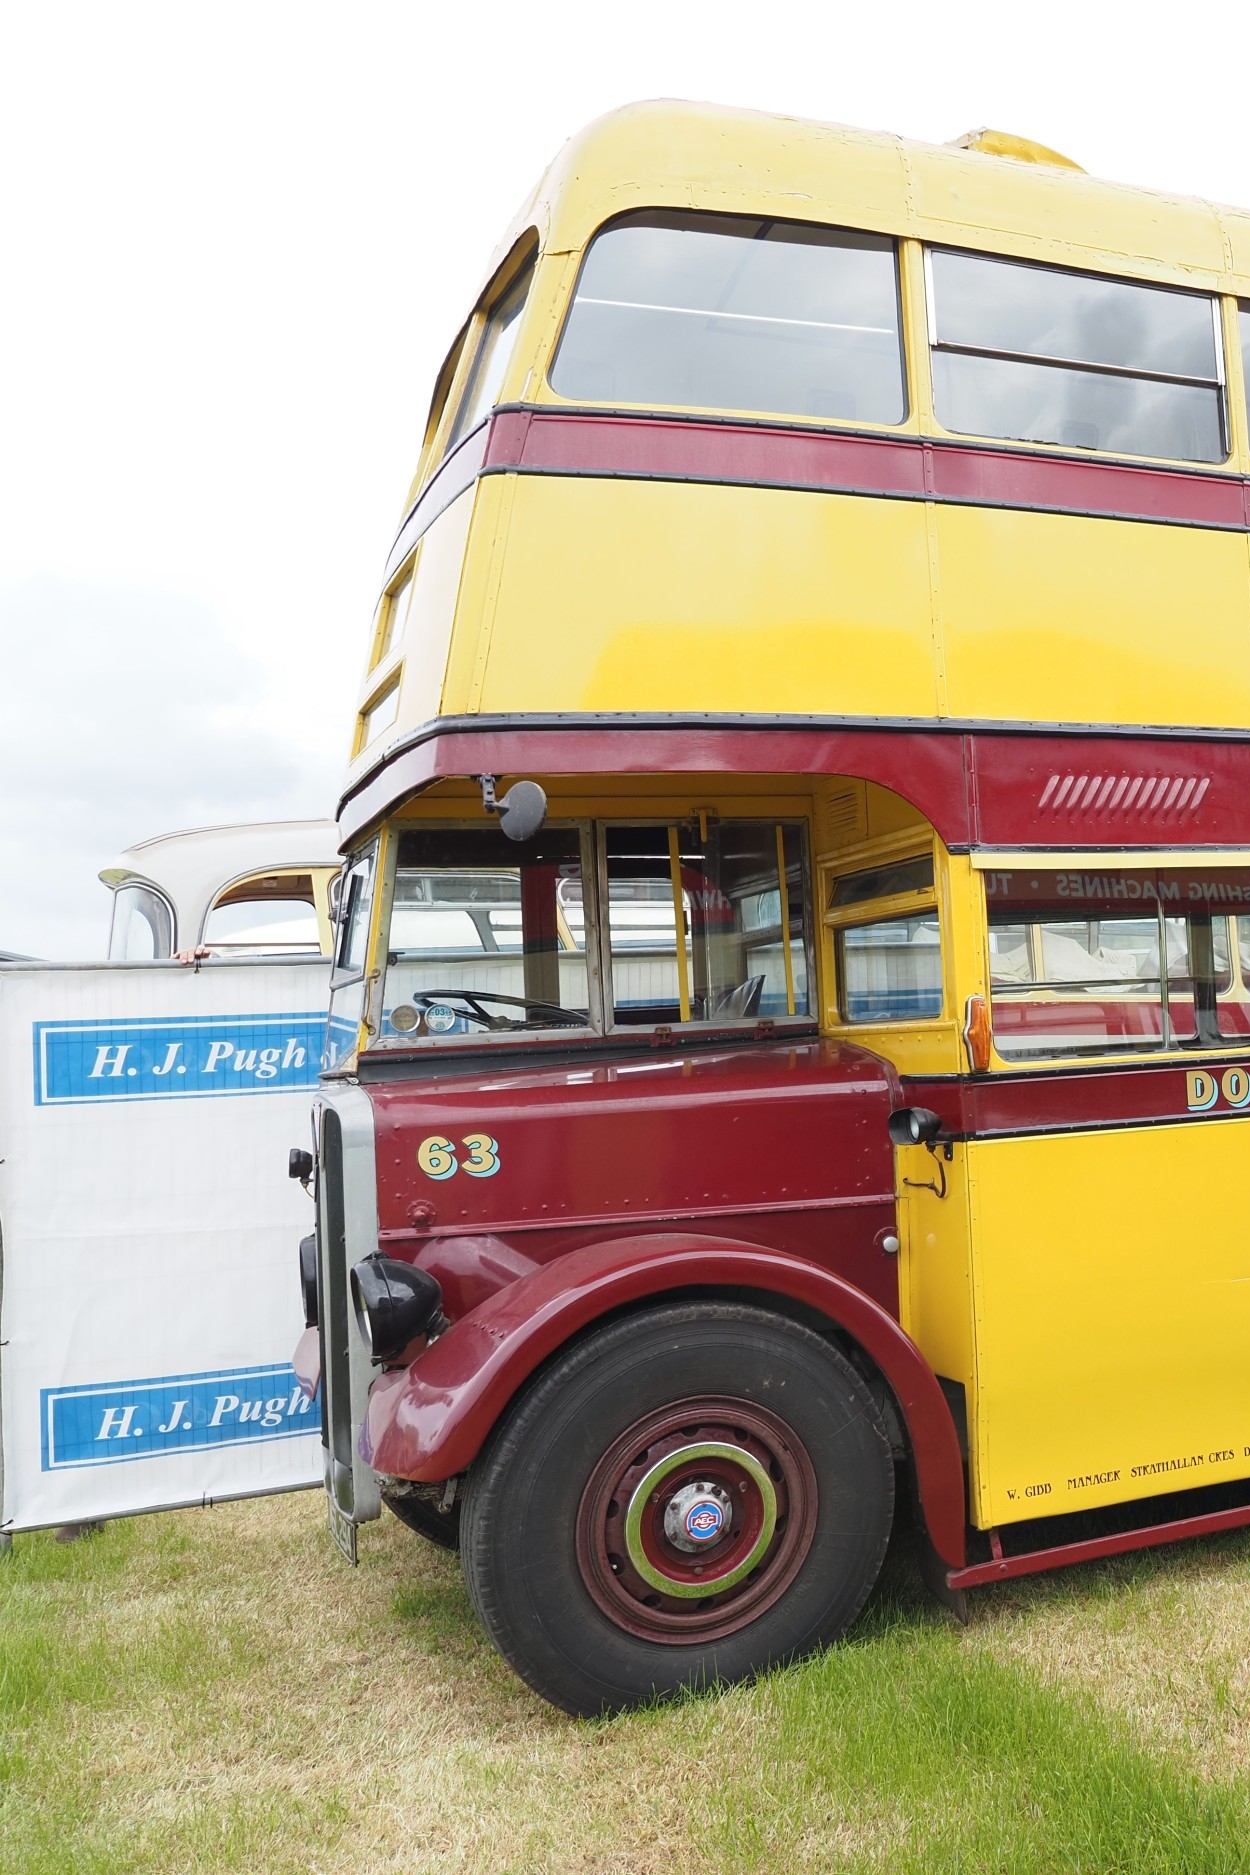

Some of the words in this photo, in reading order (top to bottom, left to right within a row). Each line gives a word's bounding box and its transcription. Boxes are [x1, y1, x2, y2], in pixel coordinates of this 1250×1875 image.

[88, 1044, 137, 1078] H.
[152, 1043, 187, 1075] J.
[201, 1037, 306, 1079] Pugh
[417, 1132, 501, 1180] 63
[94, 1405, 143, 1441] H.
[158, 1400, 193, 1433] J.
[207, 1387, 311, 1427] Pugh
[1007, 1489, 1020, 1500] W.
[1067, 1470, 1121, 1489] MANAGER
[694, 1516, 716, 1527] AEC
